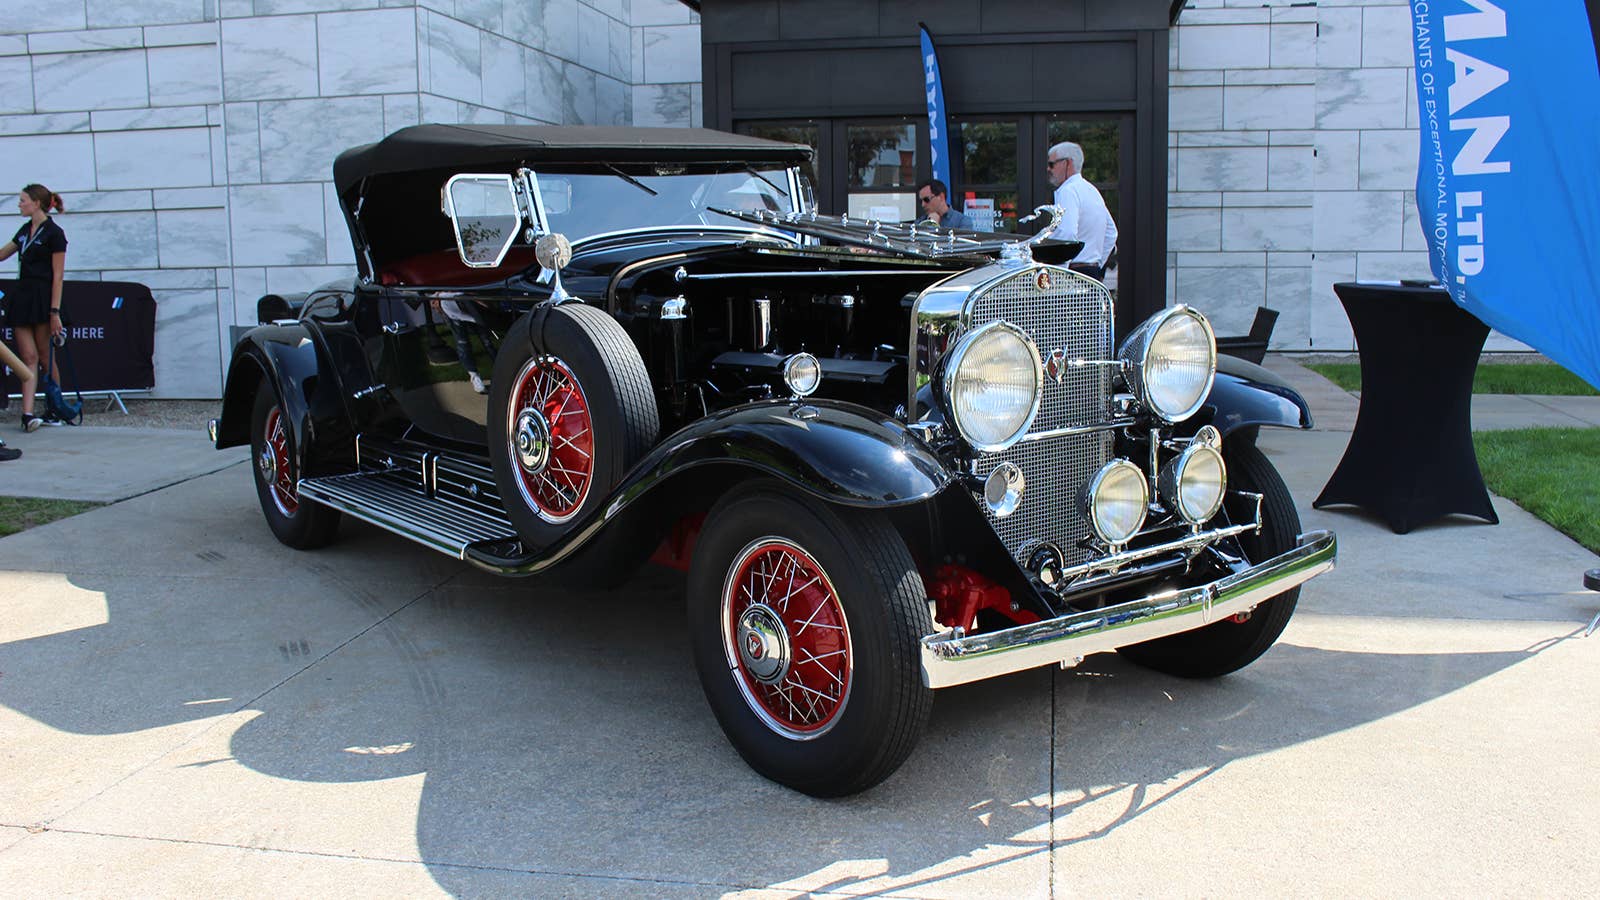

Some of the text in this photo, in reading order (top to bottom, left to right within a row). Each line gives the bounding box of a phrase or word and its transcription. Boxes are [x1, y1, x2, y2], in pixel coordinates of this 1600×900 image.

[1421, 72, 1434, 96] OF
[1425, 100, 1448, 208] EXCEPTIONAL
[1455, 191, 1485, 285] LTD.
[72, 327, 104, 339] HERE
